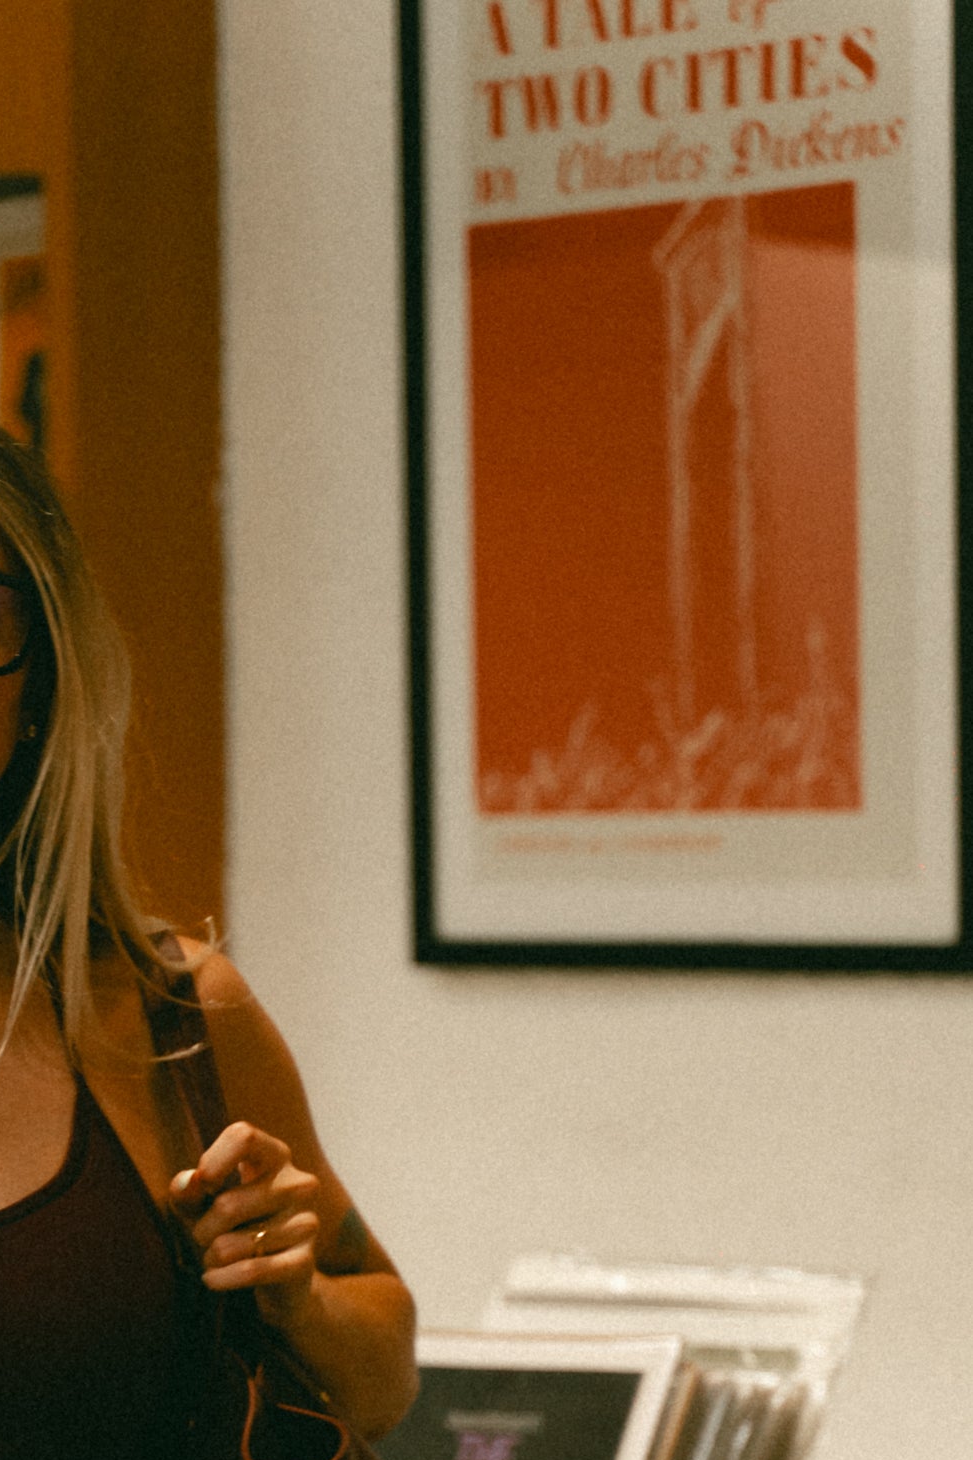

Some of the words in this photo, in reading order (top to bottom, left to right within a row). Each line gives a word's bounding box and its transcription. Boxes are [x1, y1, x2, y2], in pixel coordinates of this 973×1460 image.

[475, 1, 513, 56] A
[474, 64, 613, 139] TWO
[638, 27, 878, 119] CITIES
[555, 130, 711, 195] Charles
[725, 110, 906, 181] Dickens
